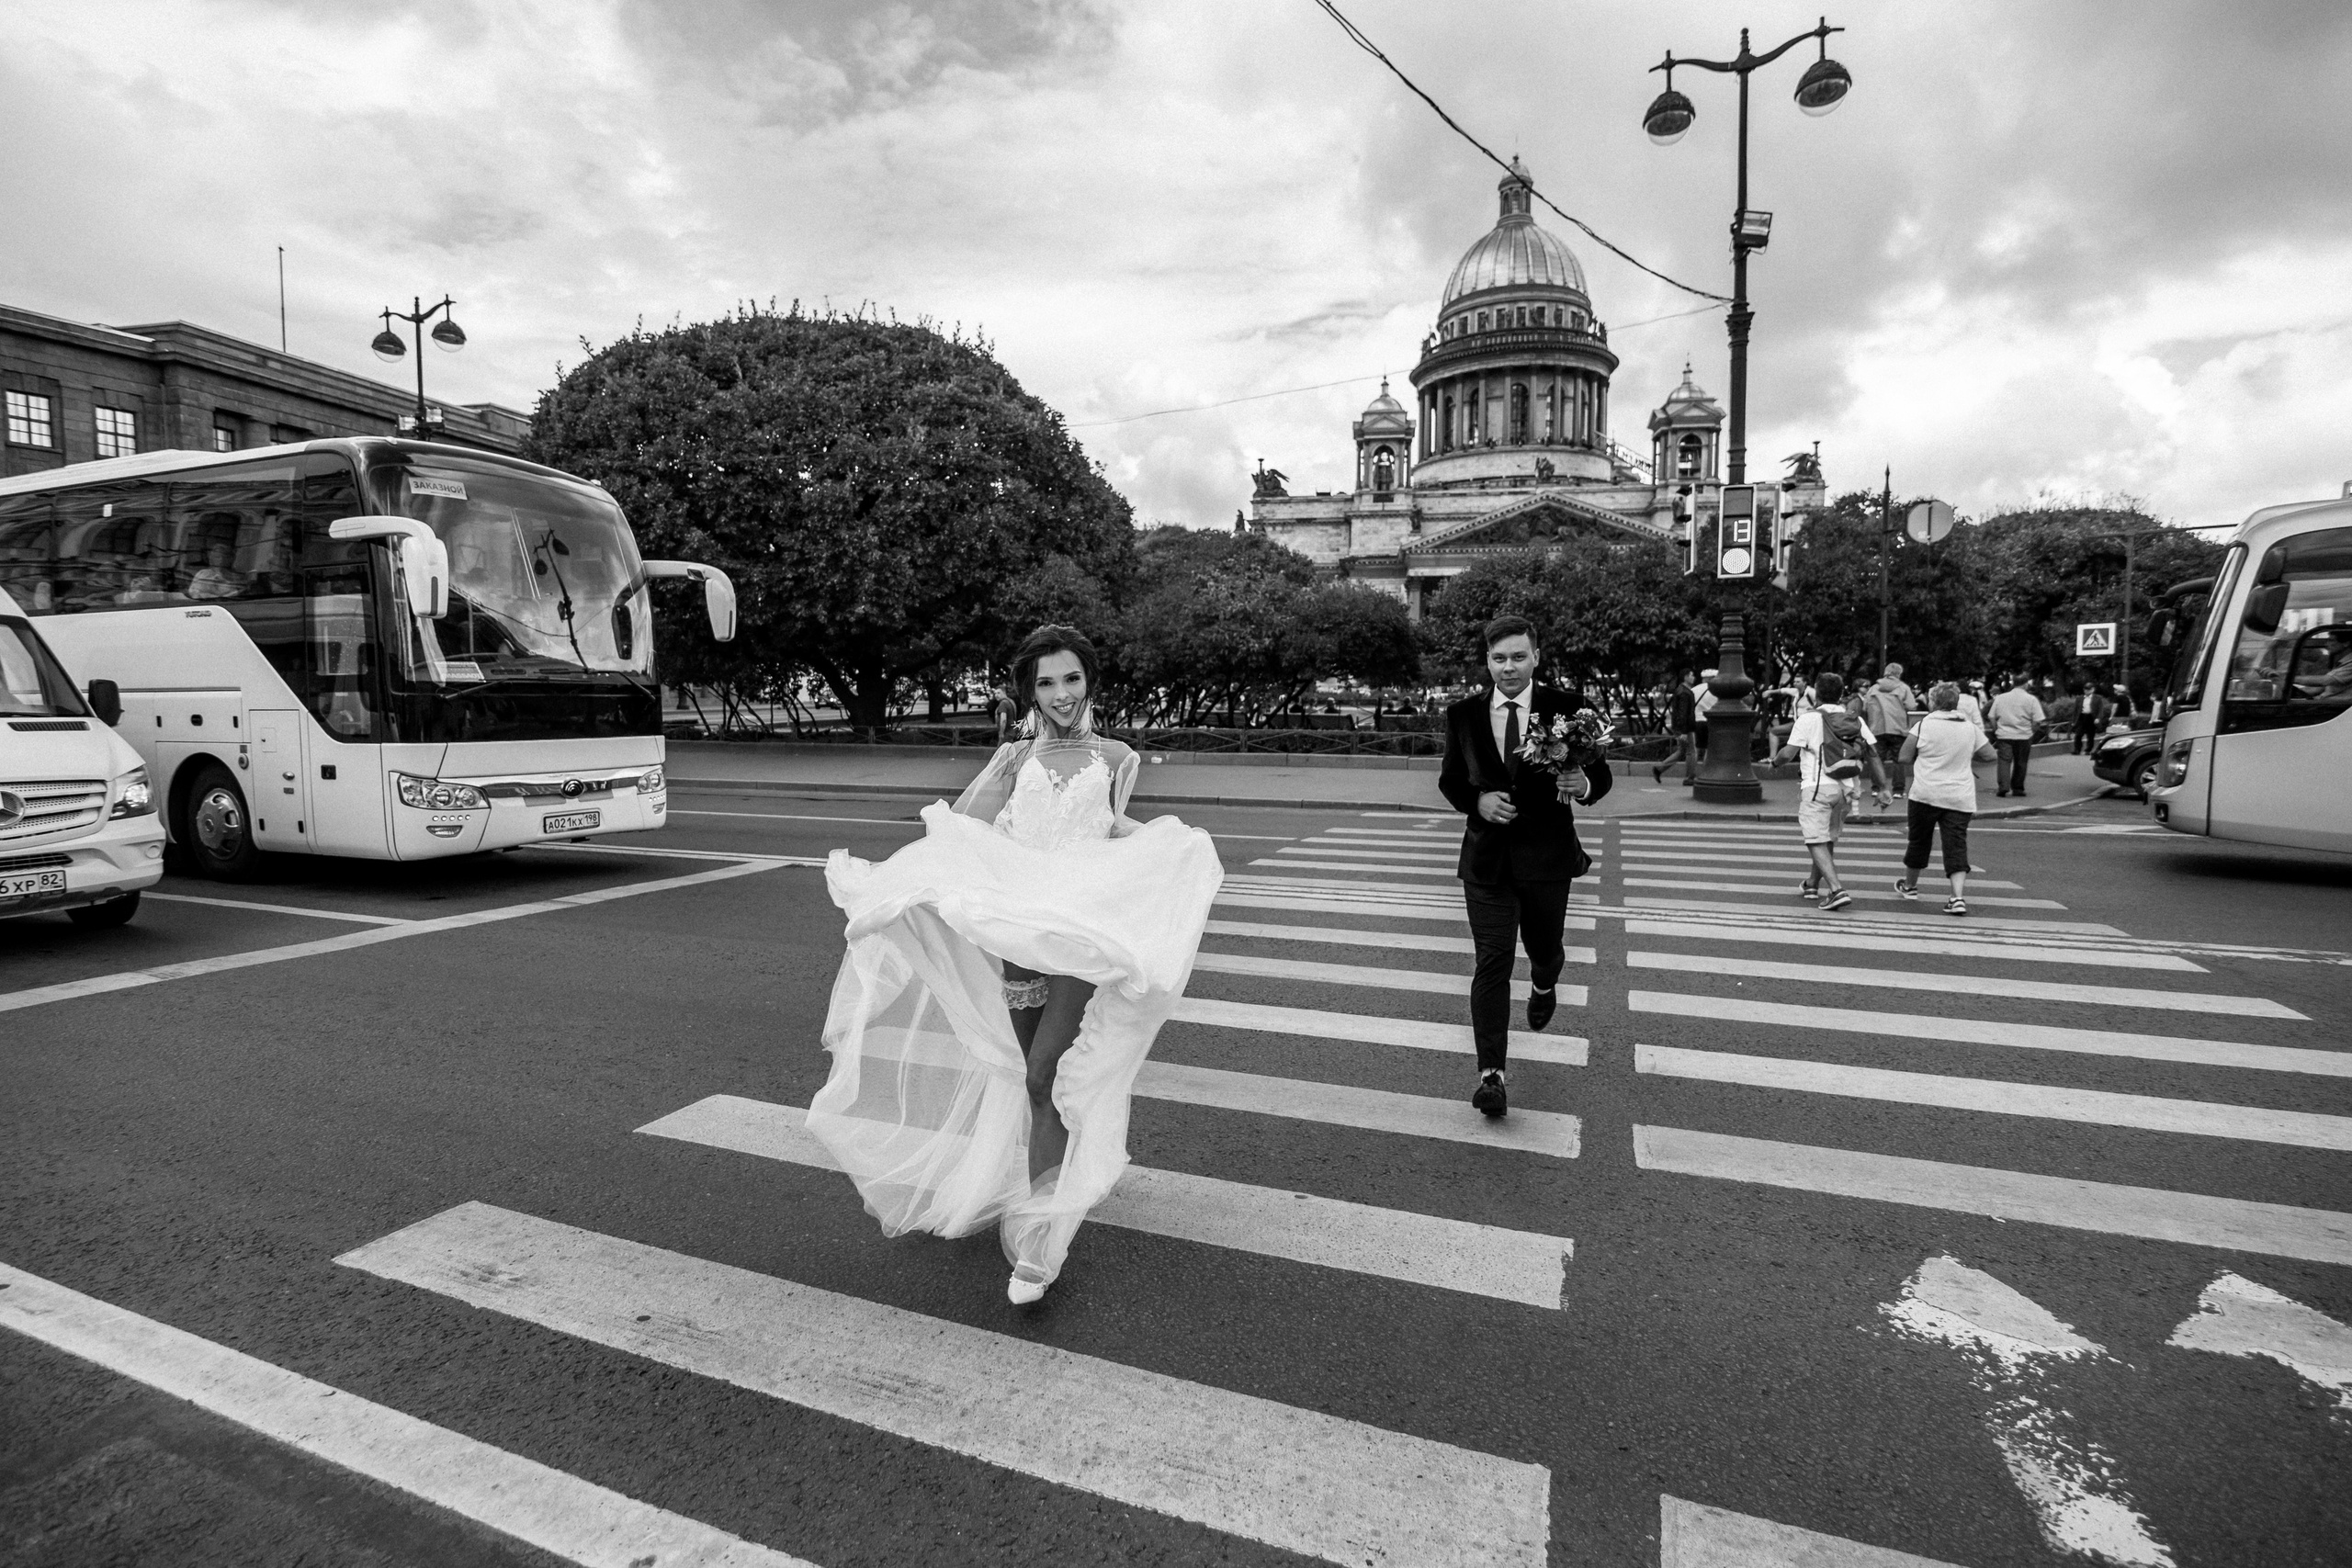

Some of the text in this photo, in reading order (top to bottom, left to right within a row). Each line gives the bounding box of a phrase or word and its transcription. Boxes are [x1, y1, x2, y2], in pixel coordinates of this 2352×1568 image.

[413, 480, 464, 494] ЗАКАЗНОЙ
[1733, 519, 1751, 542] 13
[584, 813, 598, 823] 198
[40, 874, 58, 886] 82
